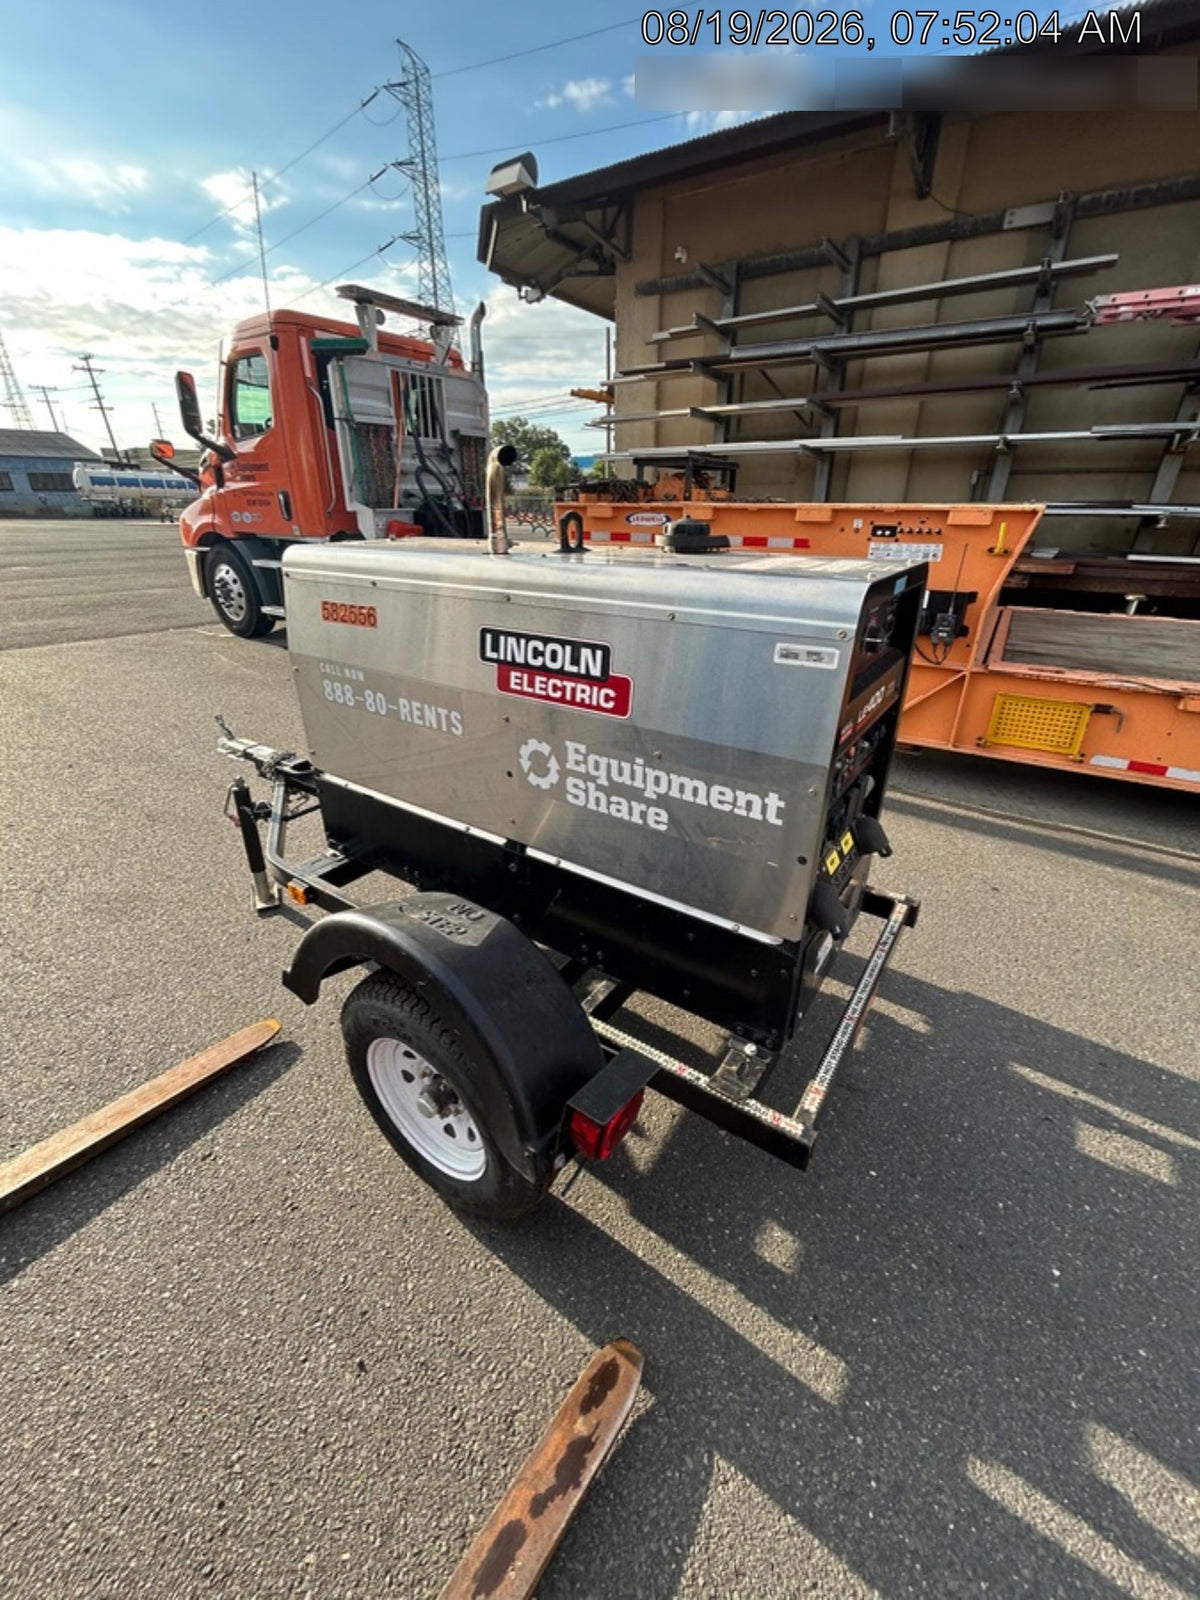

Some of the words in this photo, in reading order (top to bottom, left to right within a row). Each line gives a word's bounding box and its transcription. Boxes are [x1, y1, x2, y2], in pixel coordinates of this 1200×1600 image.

[321, 601, 377, 626] 582556
[484, 633, 603, 676] LINCOLN
[319, 662, 342, 676] CALL
[344, 668, 365, 682] NOW
[509, 671, 616, 709] ELECTRIC
[322, 679, 463, 736] 888-80-RENTS
[565, 740, 785, 827] Equipment
[565, 776, 669, 832] Share
[828, 1036, 844, 1060] STAND
[816, 1072, 827, 1087] DO
[821, 1058, 834, 1076] NOT
